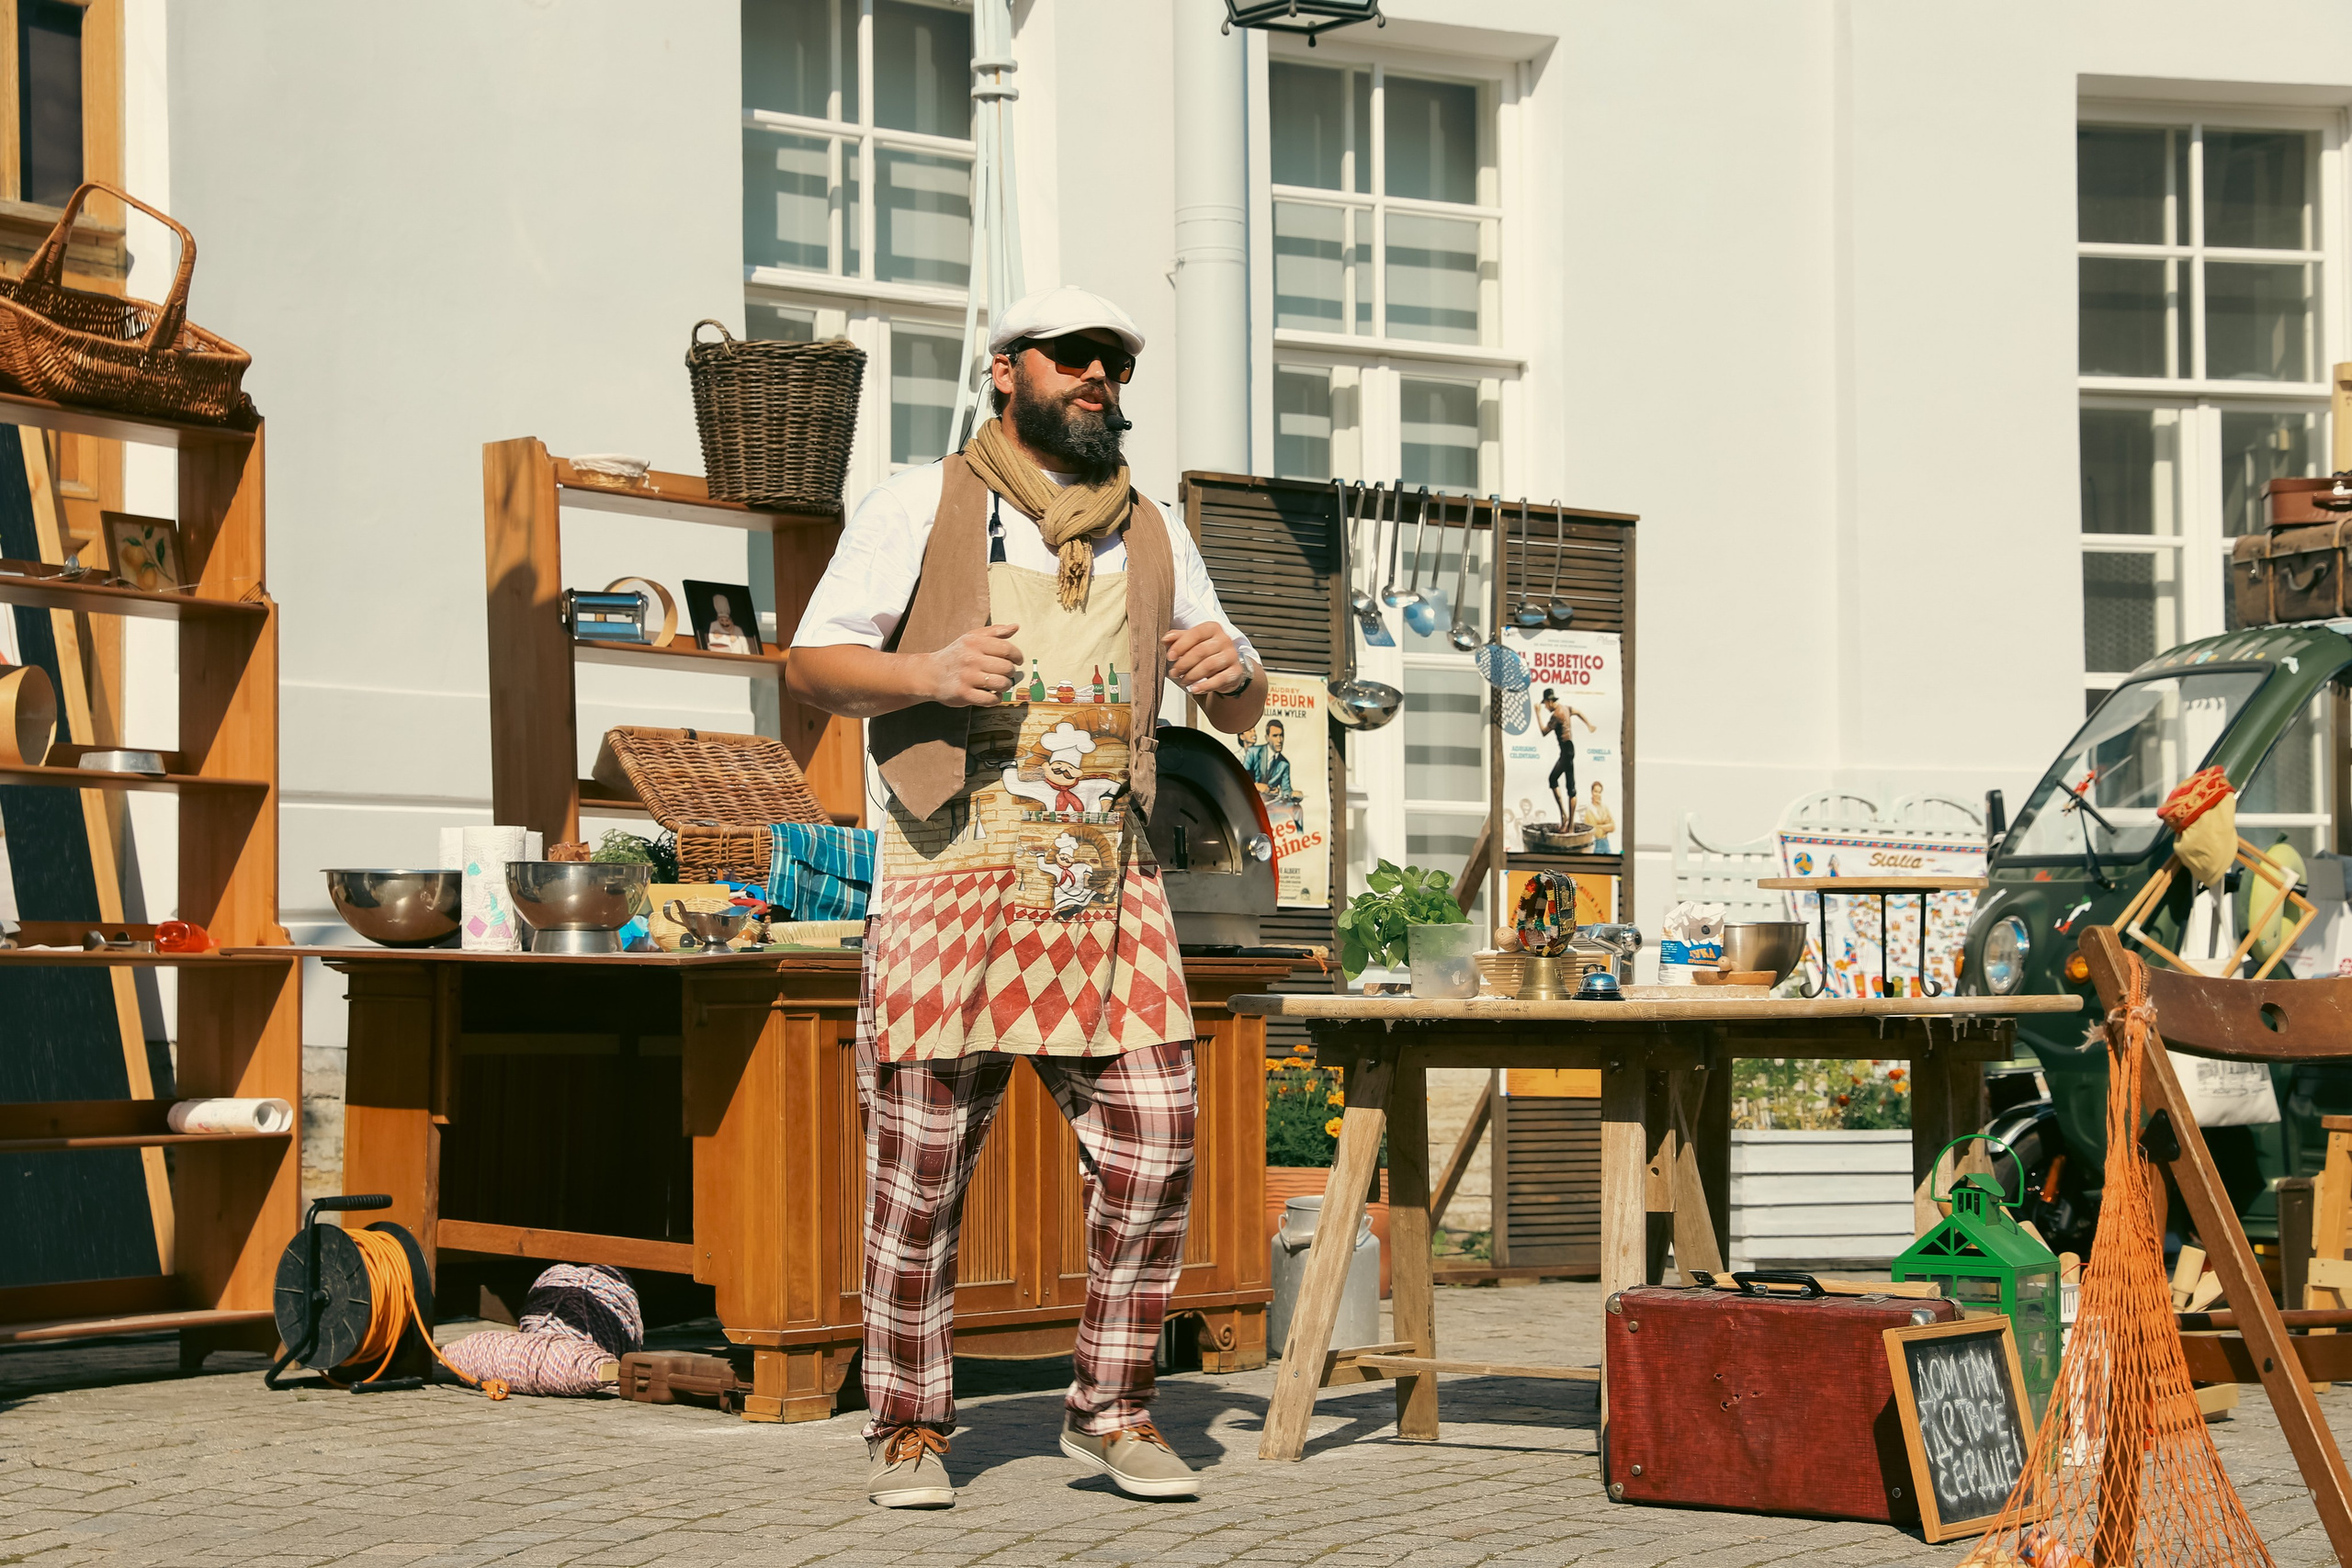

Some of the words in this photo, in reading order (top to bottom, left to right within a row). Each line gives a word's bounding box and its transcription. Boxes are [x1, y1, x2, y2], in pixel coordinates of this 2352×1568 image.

[1534, 652, 1604, 670] BISBETICO
[1530, 669, 1590, 685] DOMATO
[1284, 709, 1306, 718] WYLER
[1869, 852, 1923, 869] Sicilia
